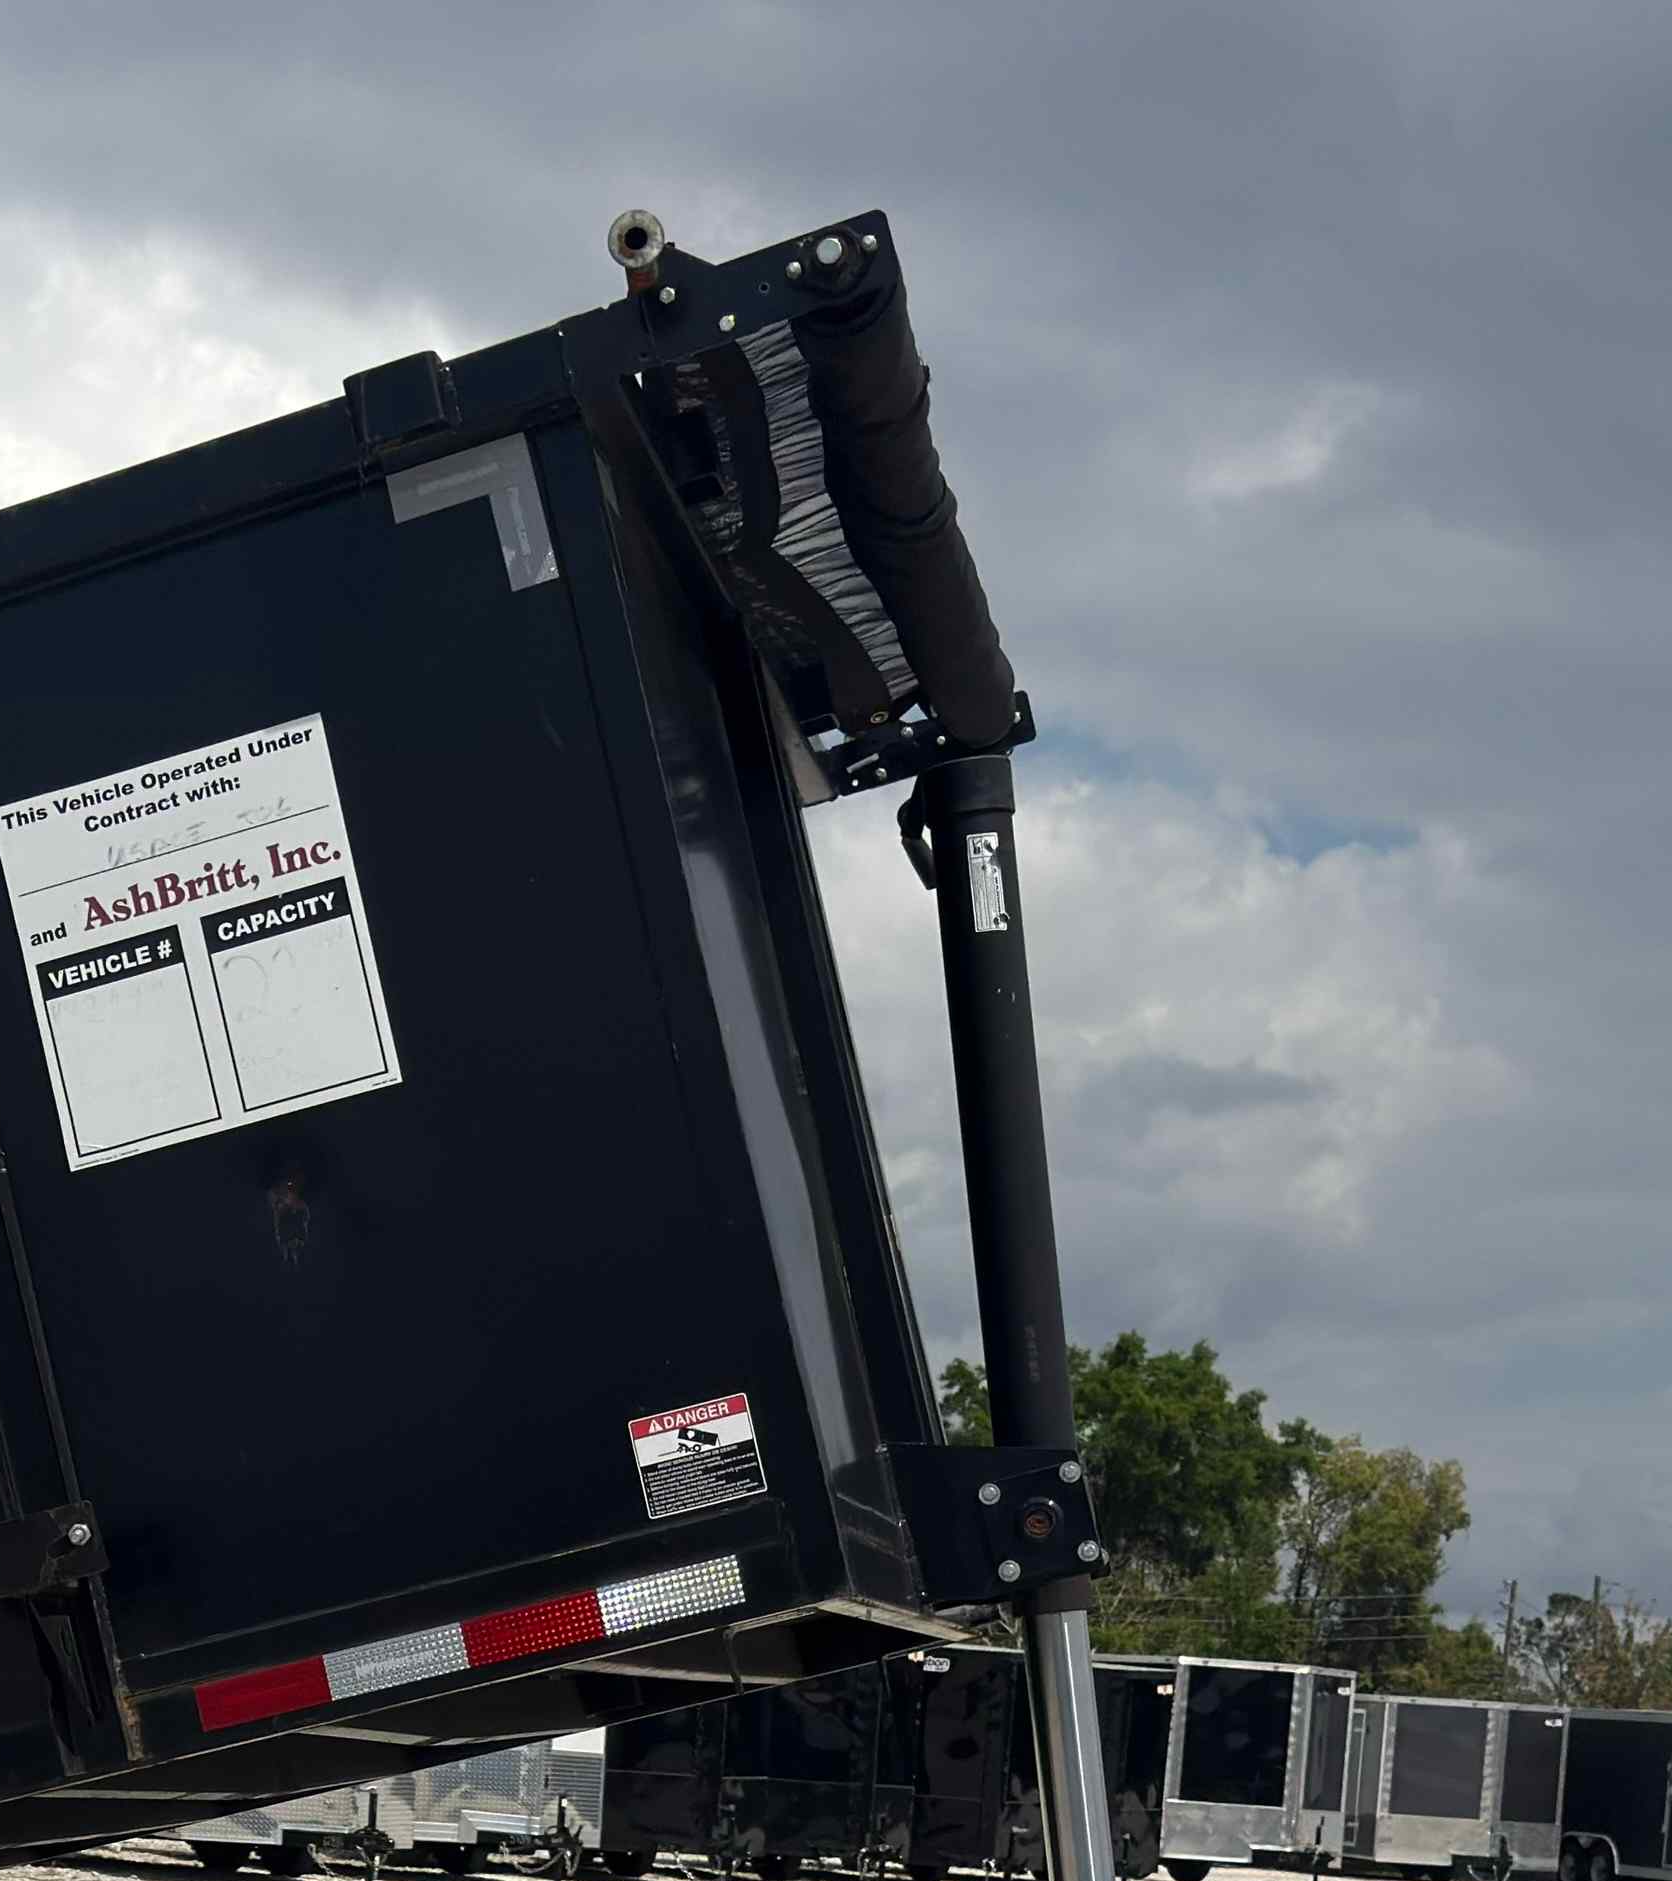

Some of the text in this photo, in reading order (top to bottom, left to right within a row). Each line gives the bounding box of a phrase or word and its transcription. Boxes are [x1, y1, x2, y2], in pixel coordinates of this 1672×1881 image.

[1, 726, 313, 831] This Vehicle Operated Under
[84, 775, 241, 833] Contract with:
[30, 838, 342, 947] and AshBritt, Inc.
[217, 893, 336, 942] CAPACITY
[48, 939, 173, 990] VEHICLE #
[662, 1402, 730, 1430] DANGER
